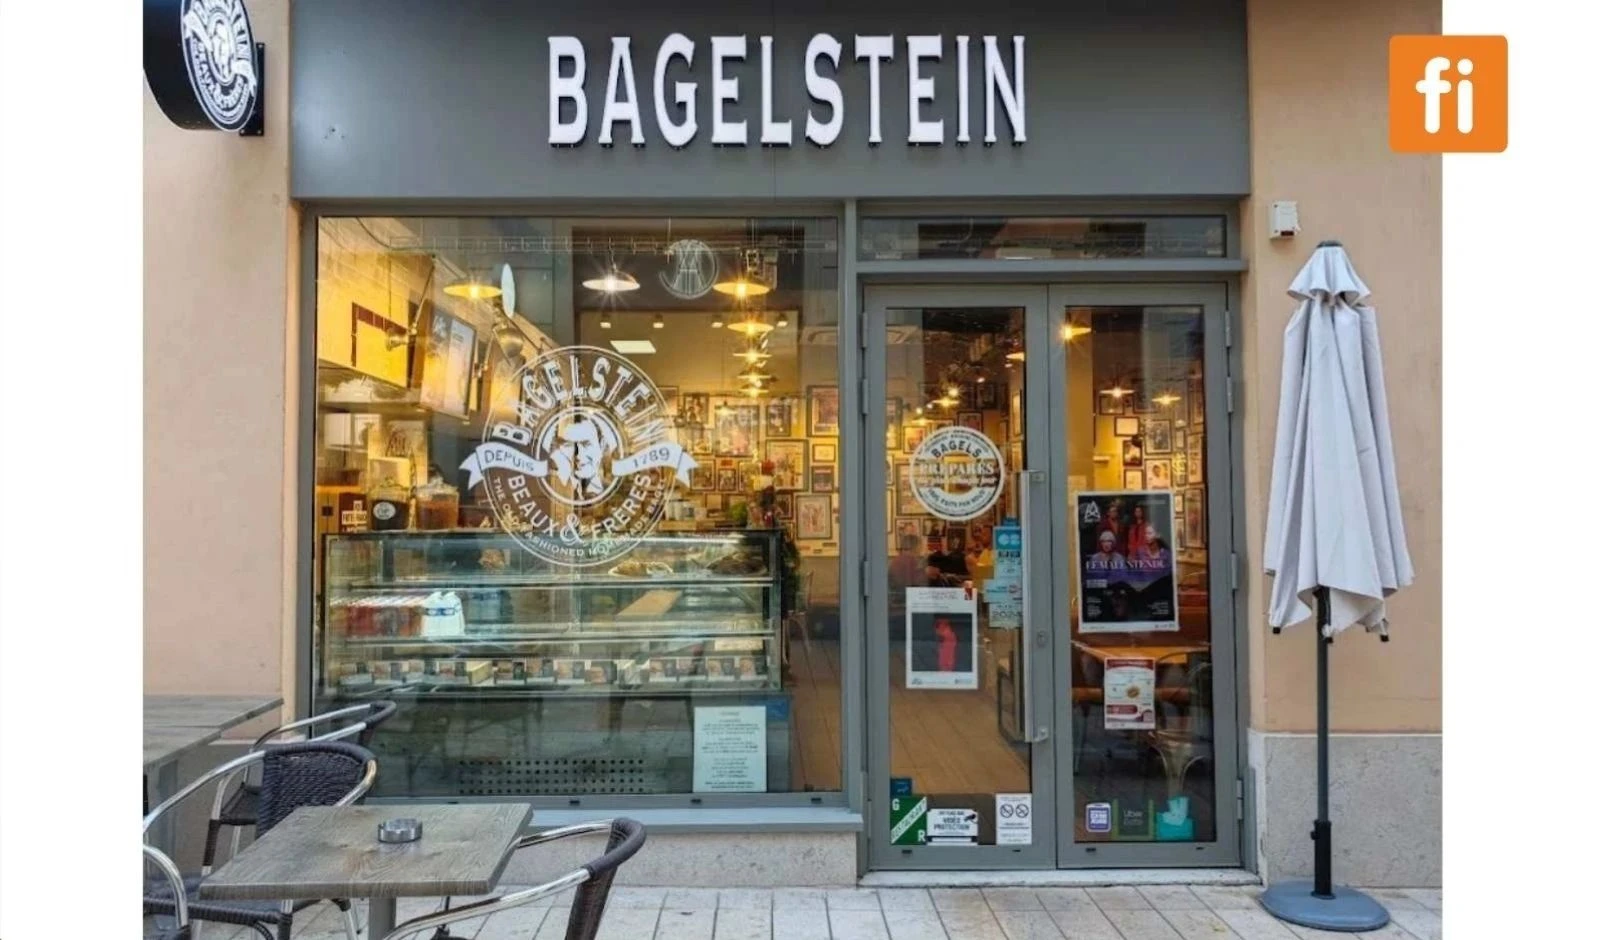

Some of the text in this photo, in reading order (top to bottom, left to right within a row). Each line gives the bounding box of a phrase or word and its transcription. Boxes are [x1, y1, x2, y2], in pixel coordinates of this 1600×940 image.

[547, 33, 1027, 147] BAGELSTEIN
[491, 355, 667, 449] BAGELSTEIN
[484, 447, 671, 473] DEPUIS 1789
[931, 440, 982, 459] BAGELS
[508, 474, 560, 538] BEAUX
[560, 513, 583, 546] &
[892, 798, 900, 811] G
[917, 830, 926, 842] R
